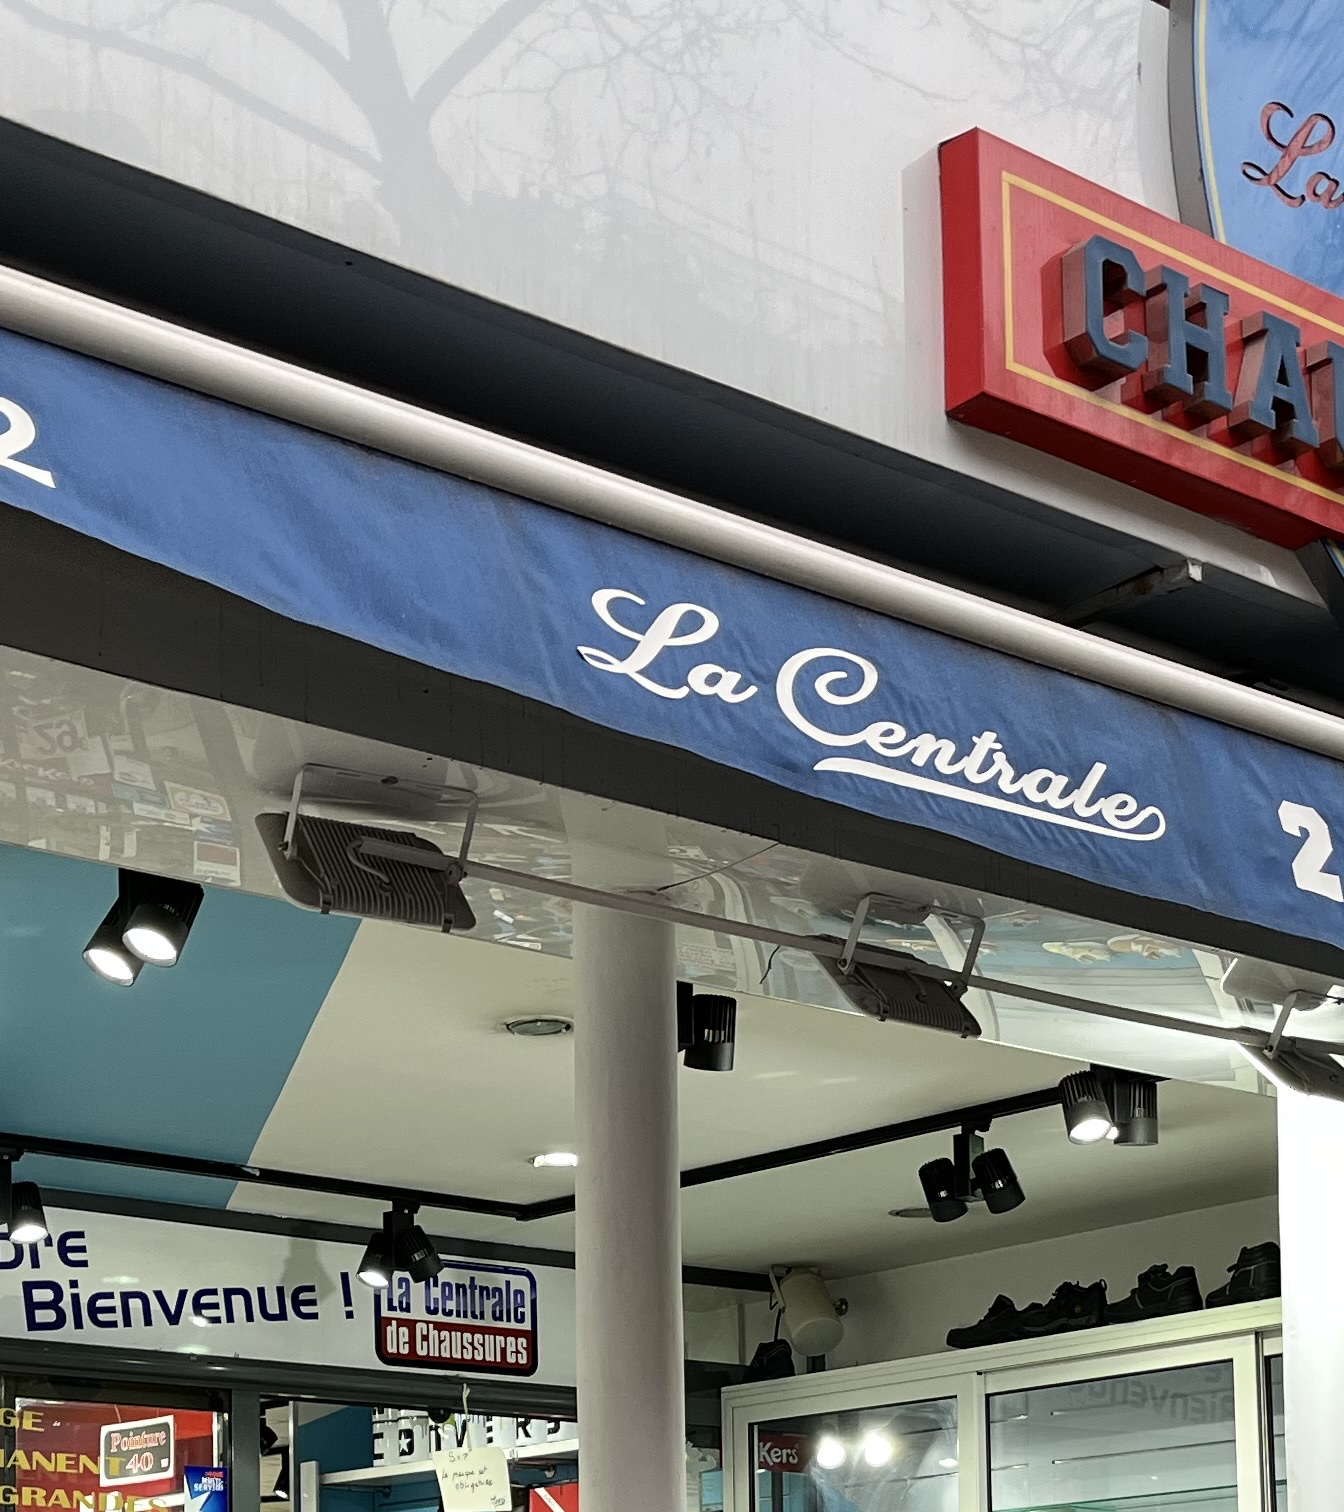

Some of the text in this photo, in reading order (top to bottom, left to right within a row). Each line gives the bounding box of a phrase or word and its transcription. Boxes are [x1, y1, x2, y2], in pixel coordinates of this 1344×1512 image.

[576, 588, 758, 704] La
[776, 648, 1166, 842] Centrale
[1278, 801, 1344, 903] 2
[22, 1279, 319, 1332] Bienvenue
[387, 1273, 526, 1324] La Centrale
[386, 1320, 528, 1364] de Chaussures
[110, 1431, 167, 1453] Pointure
[126, 1452, 155, 1474] 40
